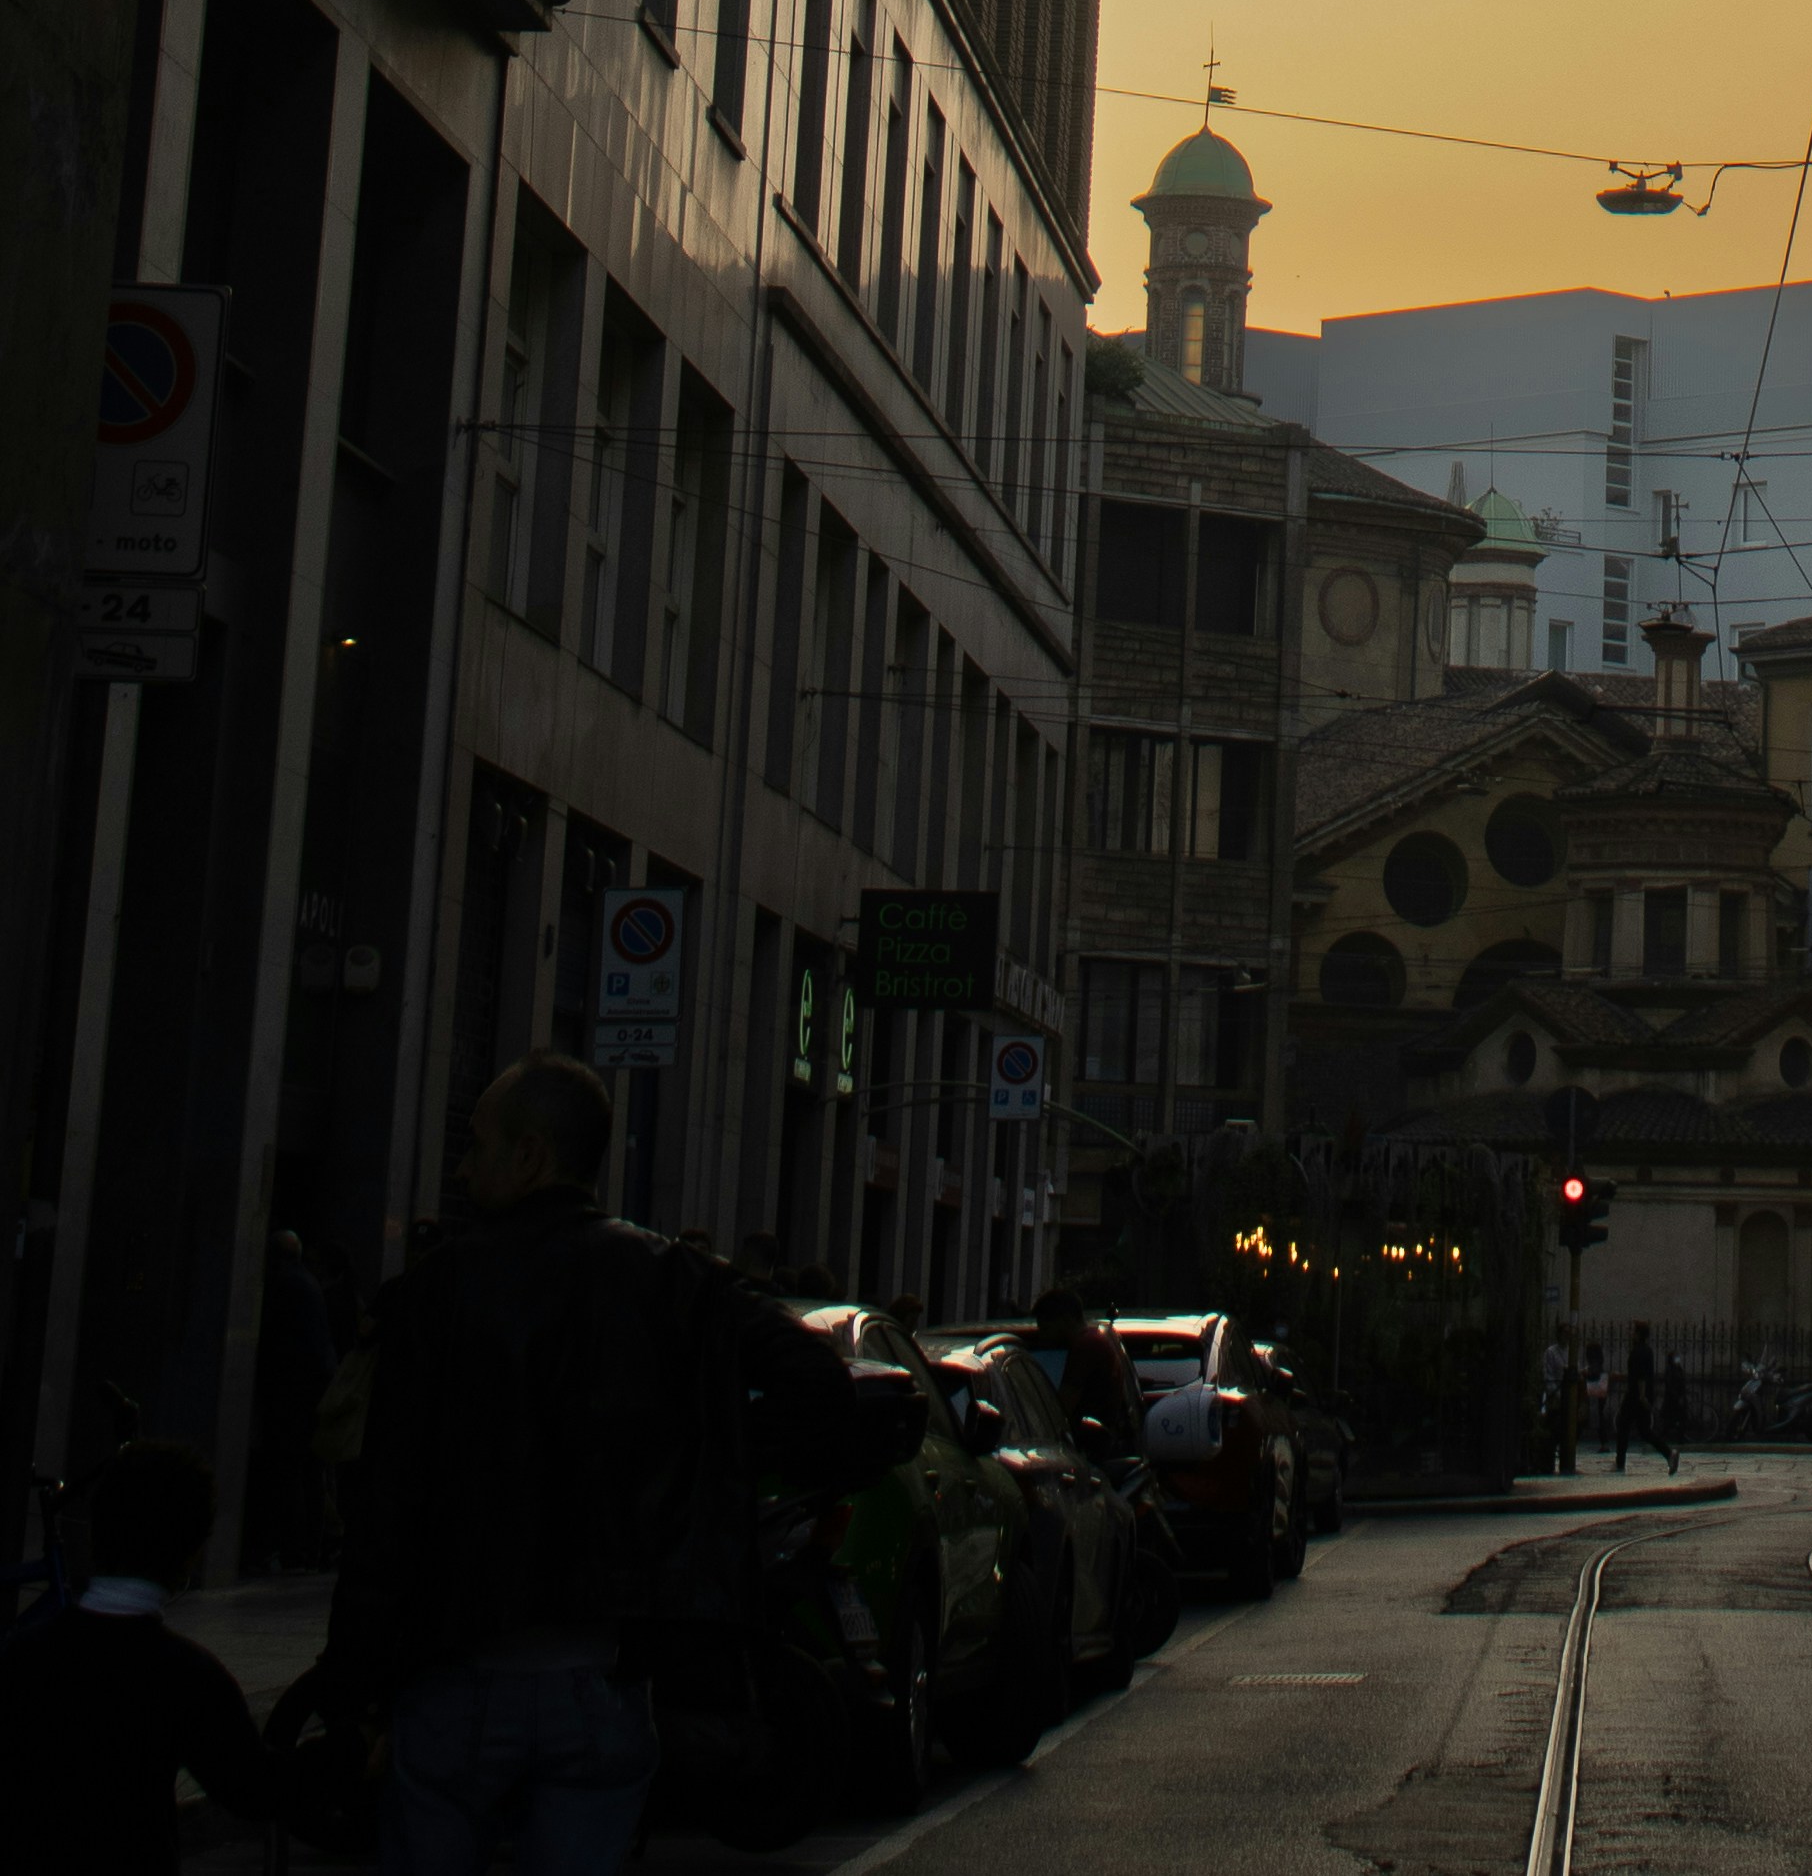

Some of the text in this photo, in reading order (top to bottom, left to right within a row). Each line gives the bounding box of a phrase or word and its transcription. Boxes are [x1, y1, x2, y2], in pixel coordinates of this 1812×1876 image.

[116, 533, 177, 551] moto
[299, 889, 344, 941] APOLI
[879, 902, 968, 930] Caffè
[877, 936, 951, 964] Pizza
[874, 969, 976, 1001] Bristrot
[617, 1028, 654, 1041] 0-24
